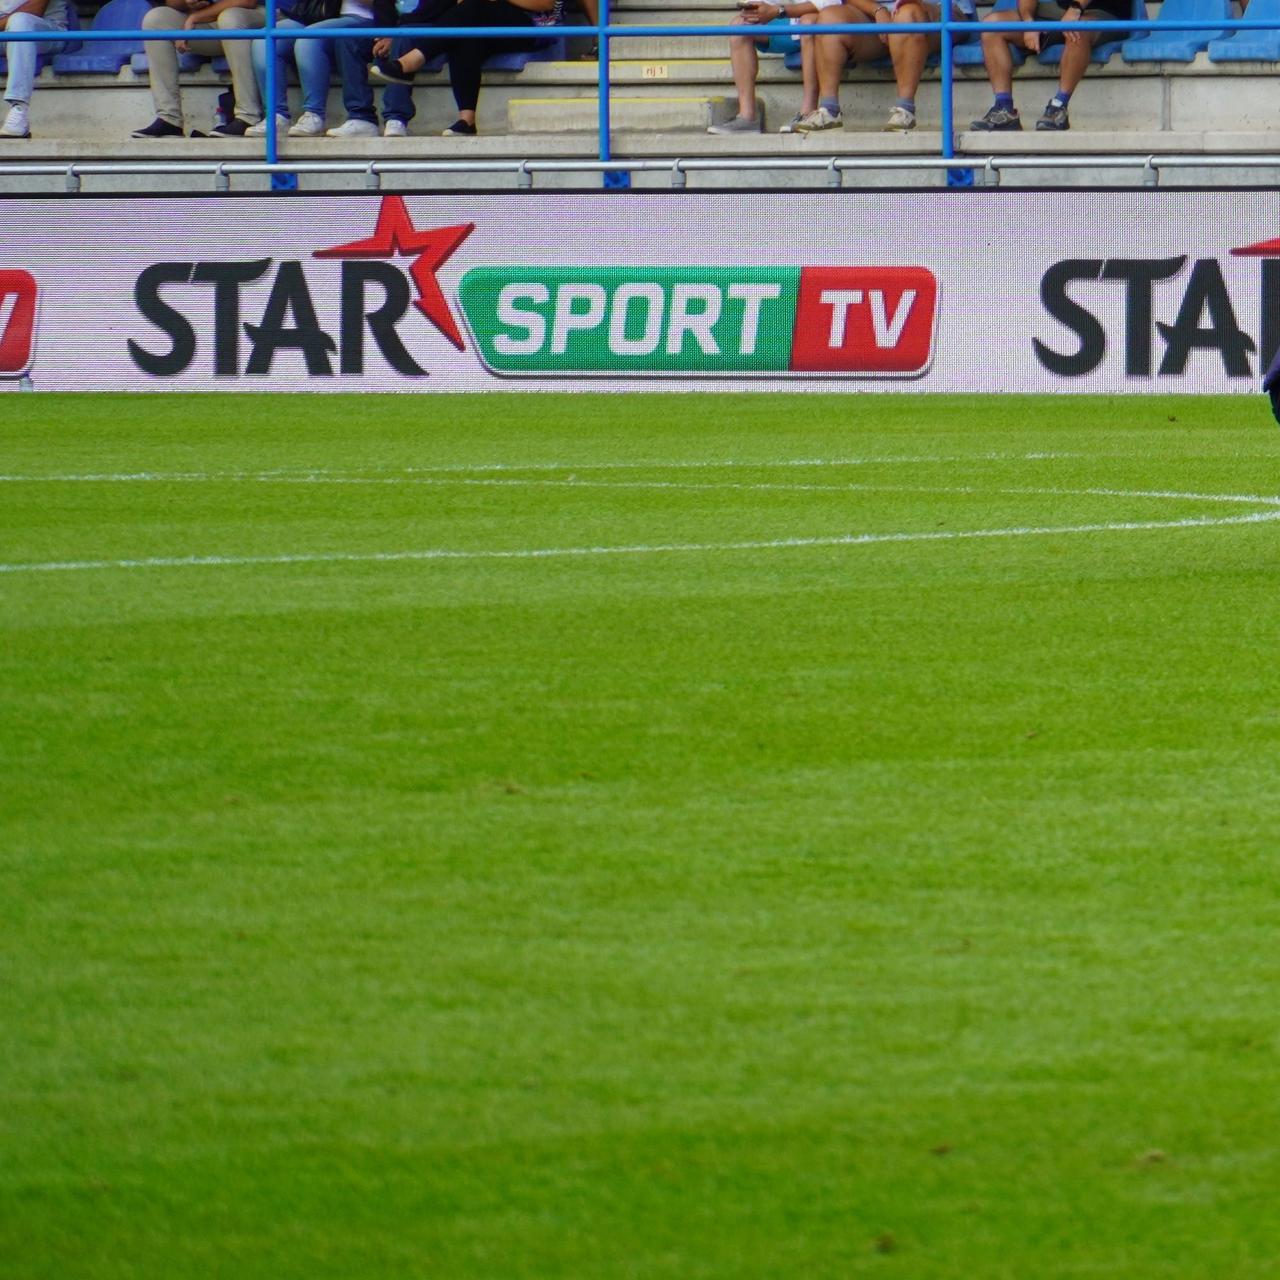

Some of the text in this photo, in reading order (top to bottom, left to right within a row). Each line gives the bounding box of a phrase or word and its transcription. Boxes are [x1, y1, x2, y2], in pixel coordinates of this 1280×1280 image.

[126, 256, 917, 377] STAR SPORT TV
